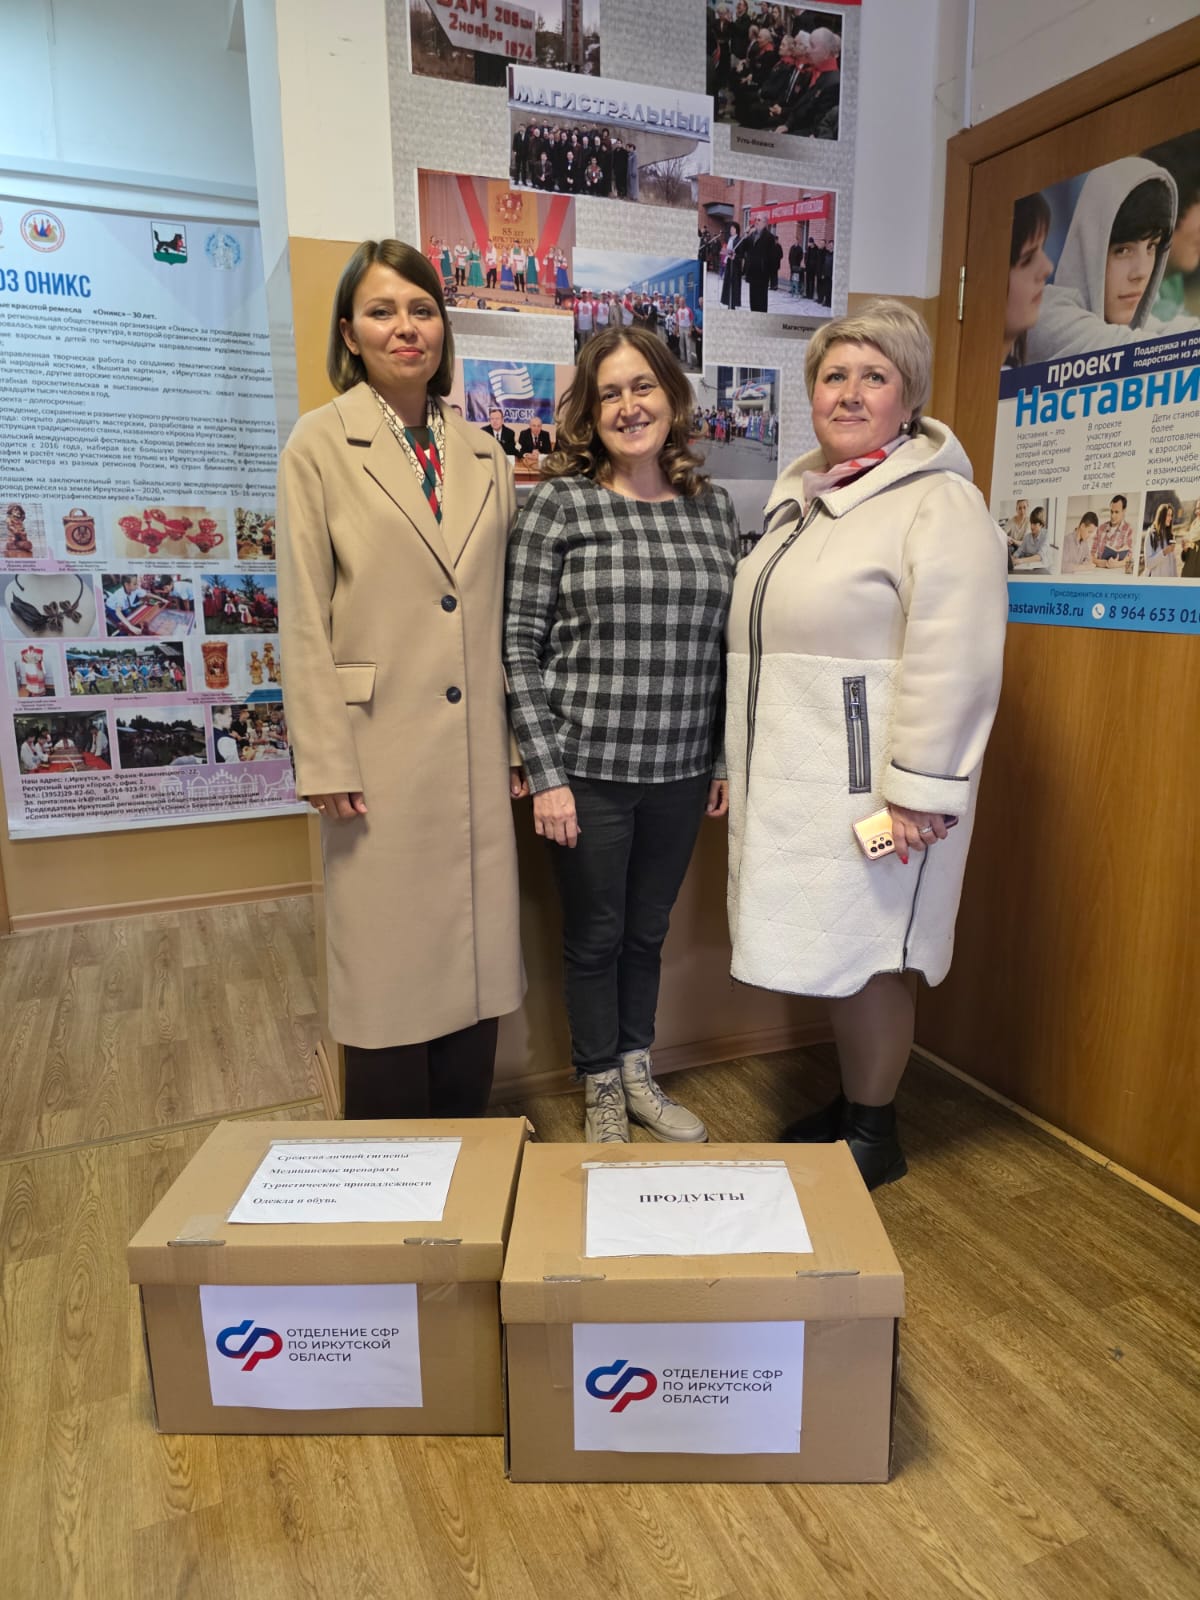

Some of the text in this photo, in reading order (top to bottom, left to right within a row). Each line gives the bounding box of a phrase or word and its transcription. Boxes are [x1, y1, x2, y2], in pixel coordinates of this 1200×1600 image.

[24, 270, 91, 298] ОНИКС
[1134, 341, 1179, 356] Поддержка
[1133, 353, 1179, 367] подросткам
[1047, 351, 1125, 387] проект
[1152, 413, 1171, 423] Дети
[1094, 420, 1122, 430] проекте
[1151, 424, 1174, 433] более
[1086, 430, 1122, 441] участвуют
[1150, 432, 1200, 444] подготовлен
[1086, 441, 1122, 451] подростки
[1155, 442, 1192, 454] взрослой
[1112, 449, 1136, 458] домов
[1093, 461, 1101, 470] 12
[1147, 456, 1173, 464] жизни,
[1109, 605, 1200, 624] 8 964 653 01
[277, 1154, 324, 1162] Средства
[262, 1181, 432, 1190] Туристические принадлежности
[253, 1197, 294, 1205] Одежда
[639, 1192, 745, 1204] ПРОДУКТЫ
[286, 1327, 400, 1339] ОТДЕЛЕНИЕ СФР
[288, 1338, 391, 1350] ПО ИРКУТСКОЙ
[288, 1353, 352, 1362] ОБЛАСТИ
[662, 1368, 784, 1380] ОТДЕЛЕНИЕ СФР
[662, 1380, 772, 1392] ПО ИРКУТСКОЙ
[662, 1394, 729, 1404] ОБЛАСТИ
